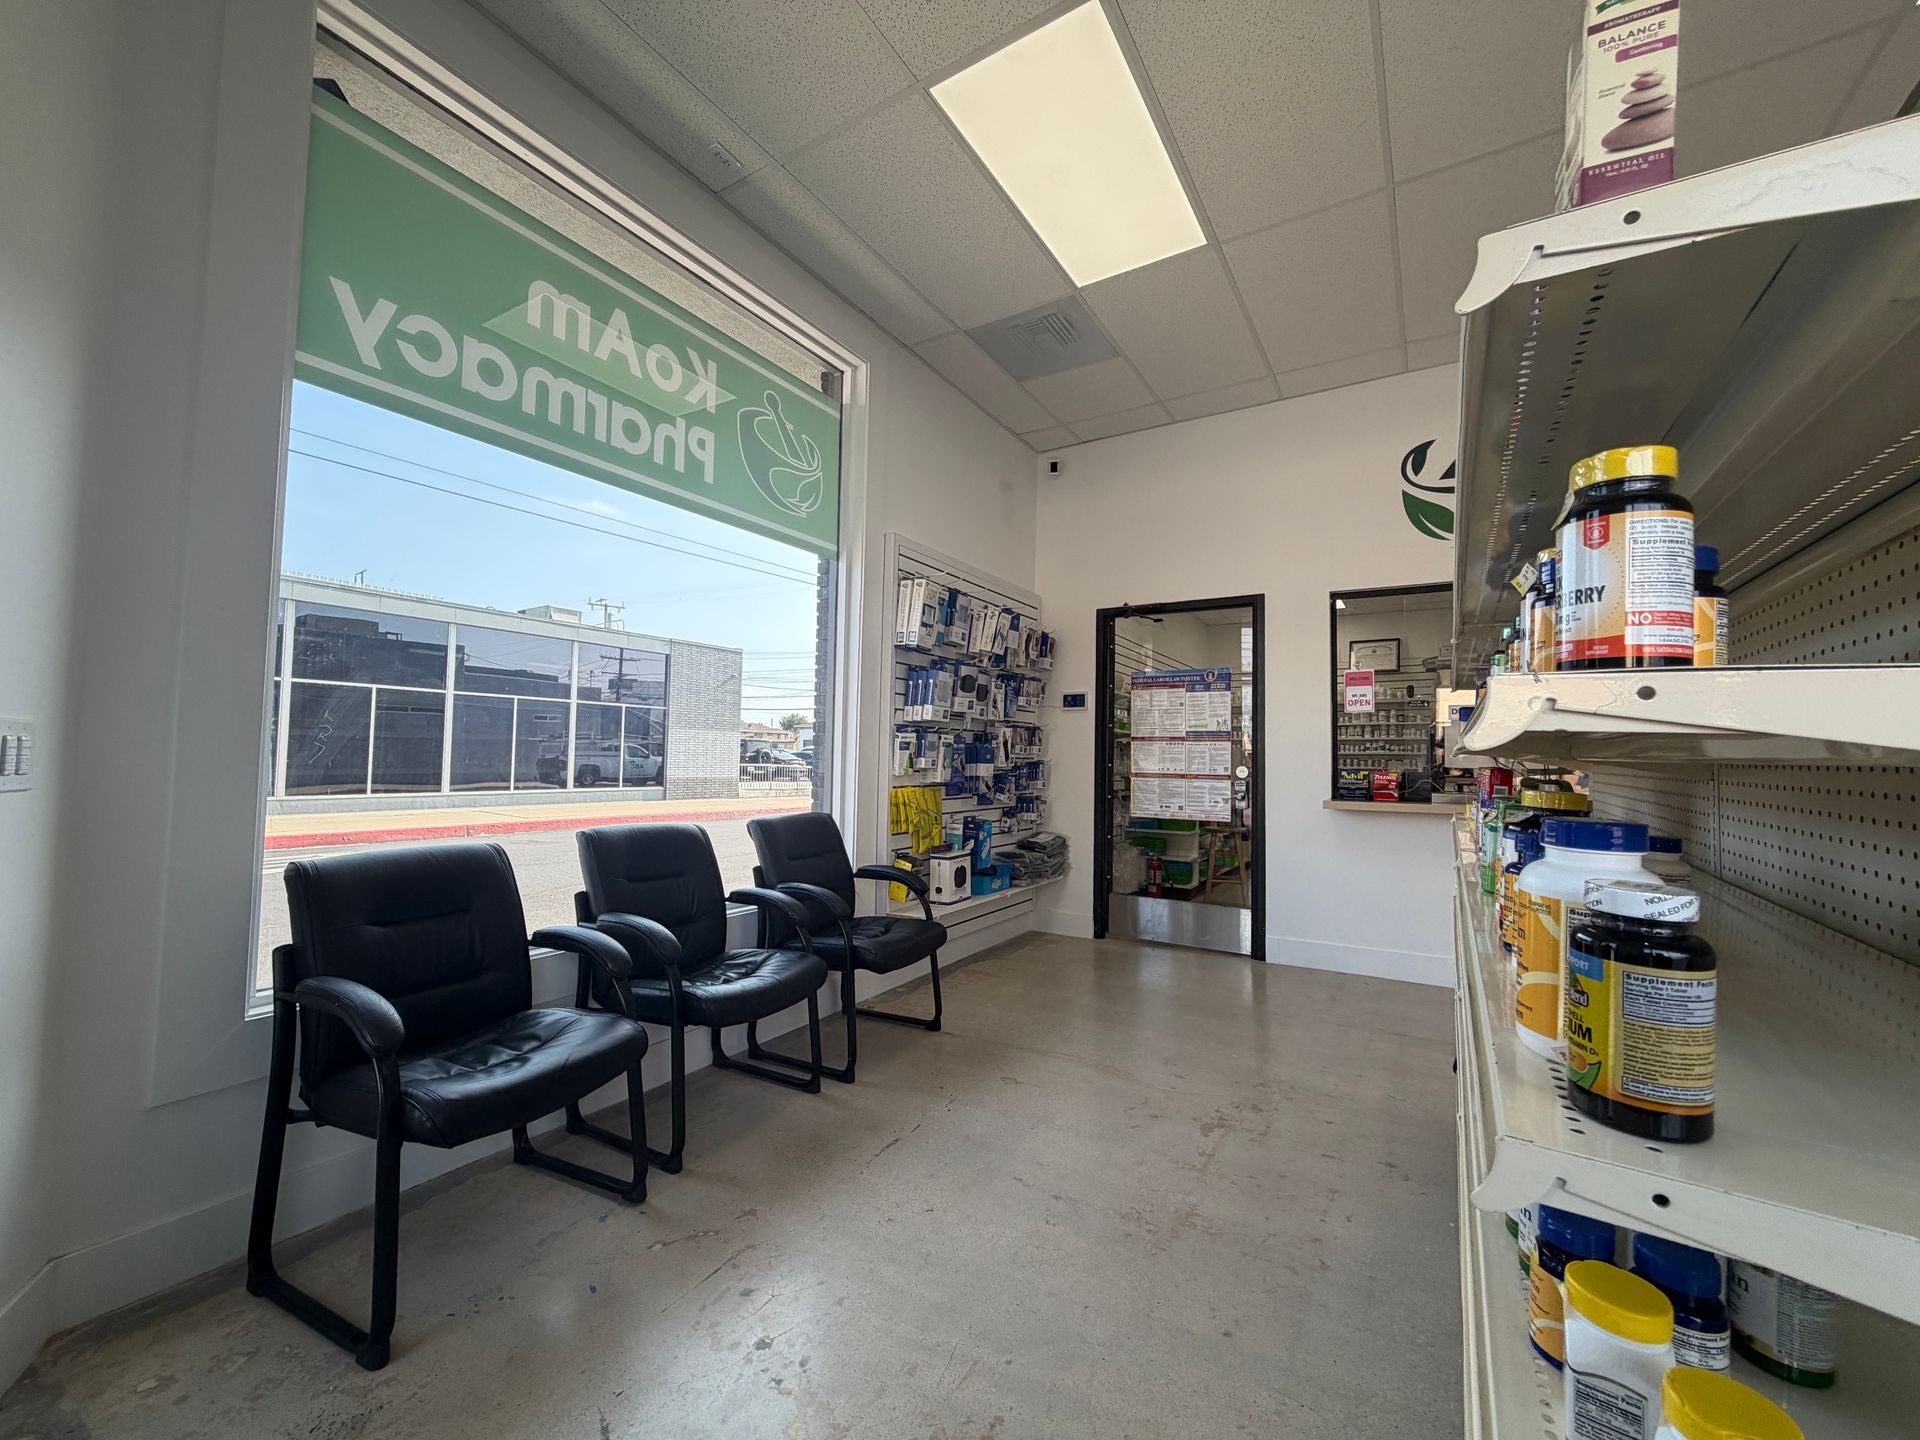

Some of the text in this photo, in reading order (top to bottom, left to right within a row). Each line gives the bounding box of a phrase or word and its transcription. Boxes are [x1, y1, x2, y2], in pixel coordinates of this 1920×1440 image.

[1603, 6, 1662, 29] AROMATHERAPY
[1598, 20, 1667, 48] BALANCE
[1603, 41, 1629, 53] 100%
[1632, 32, 1660, 44] PURE
[1588, 157, 1644, 176] ESSENTIAL
[1647, 153, 1665, 161] OIL
[1632, 538, 1686, 547] Supplement
[1627, 612, 1652, 625] NO
[1347, 699, 1371, 707] OPEN
[1344, 772, 1364, 780] Advil
[1569, 909, 1592, 918] Sup
[1643, 906, 1681, 920] SEALED
[1680, 899, 1696, 911] FOR
[1625, 973, 1694, 988] Supplement
[1576, 1378, 1619, 1401] Supplement
